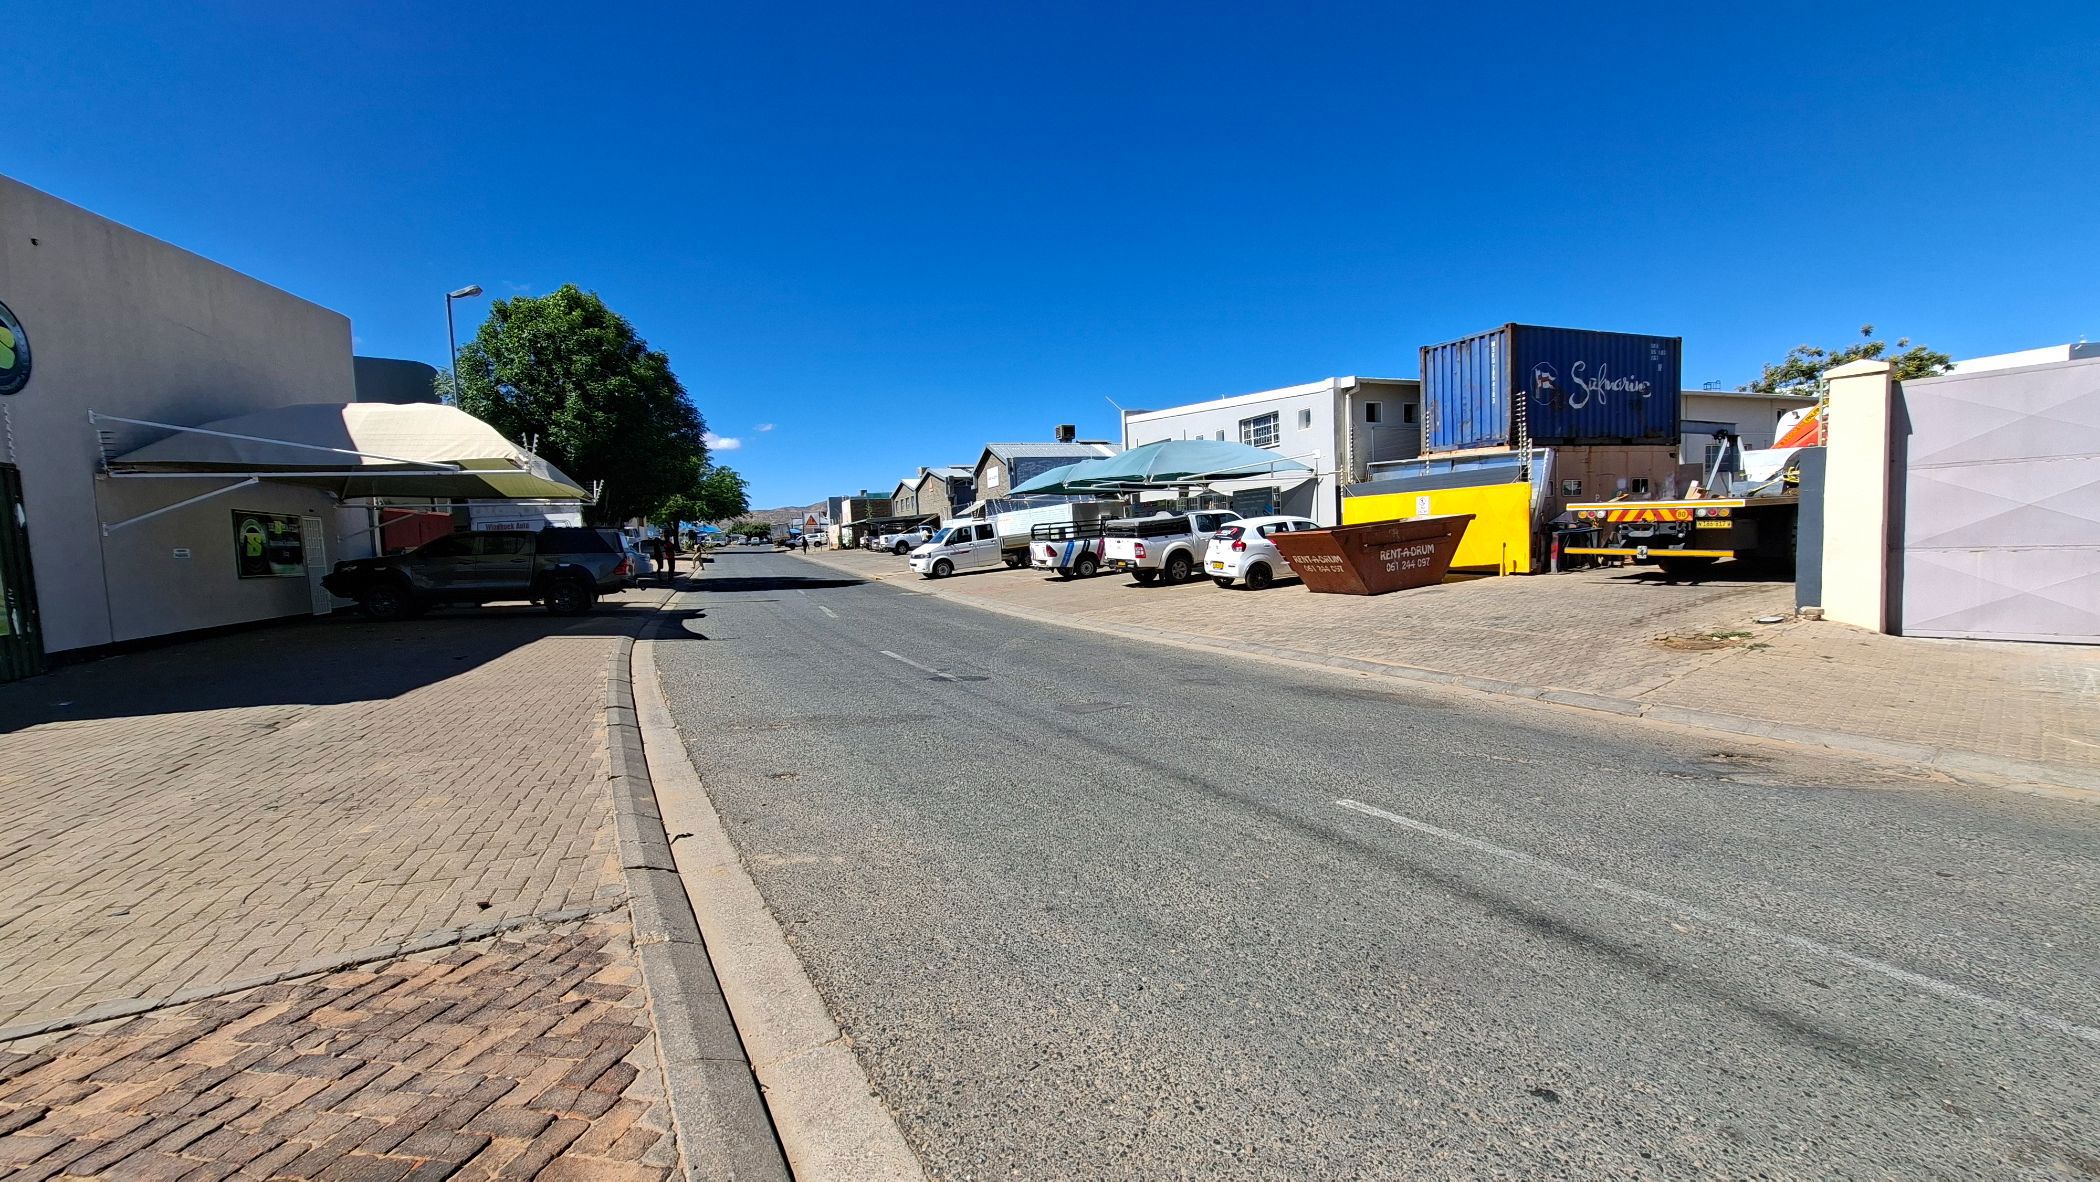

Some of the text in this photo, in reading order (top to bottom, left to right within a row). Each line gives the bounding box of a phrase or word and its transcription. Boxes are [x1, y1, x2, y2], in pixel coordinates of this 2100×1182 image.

[1386, 557, 1431, 572] 061 244 097
